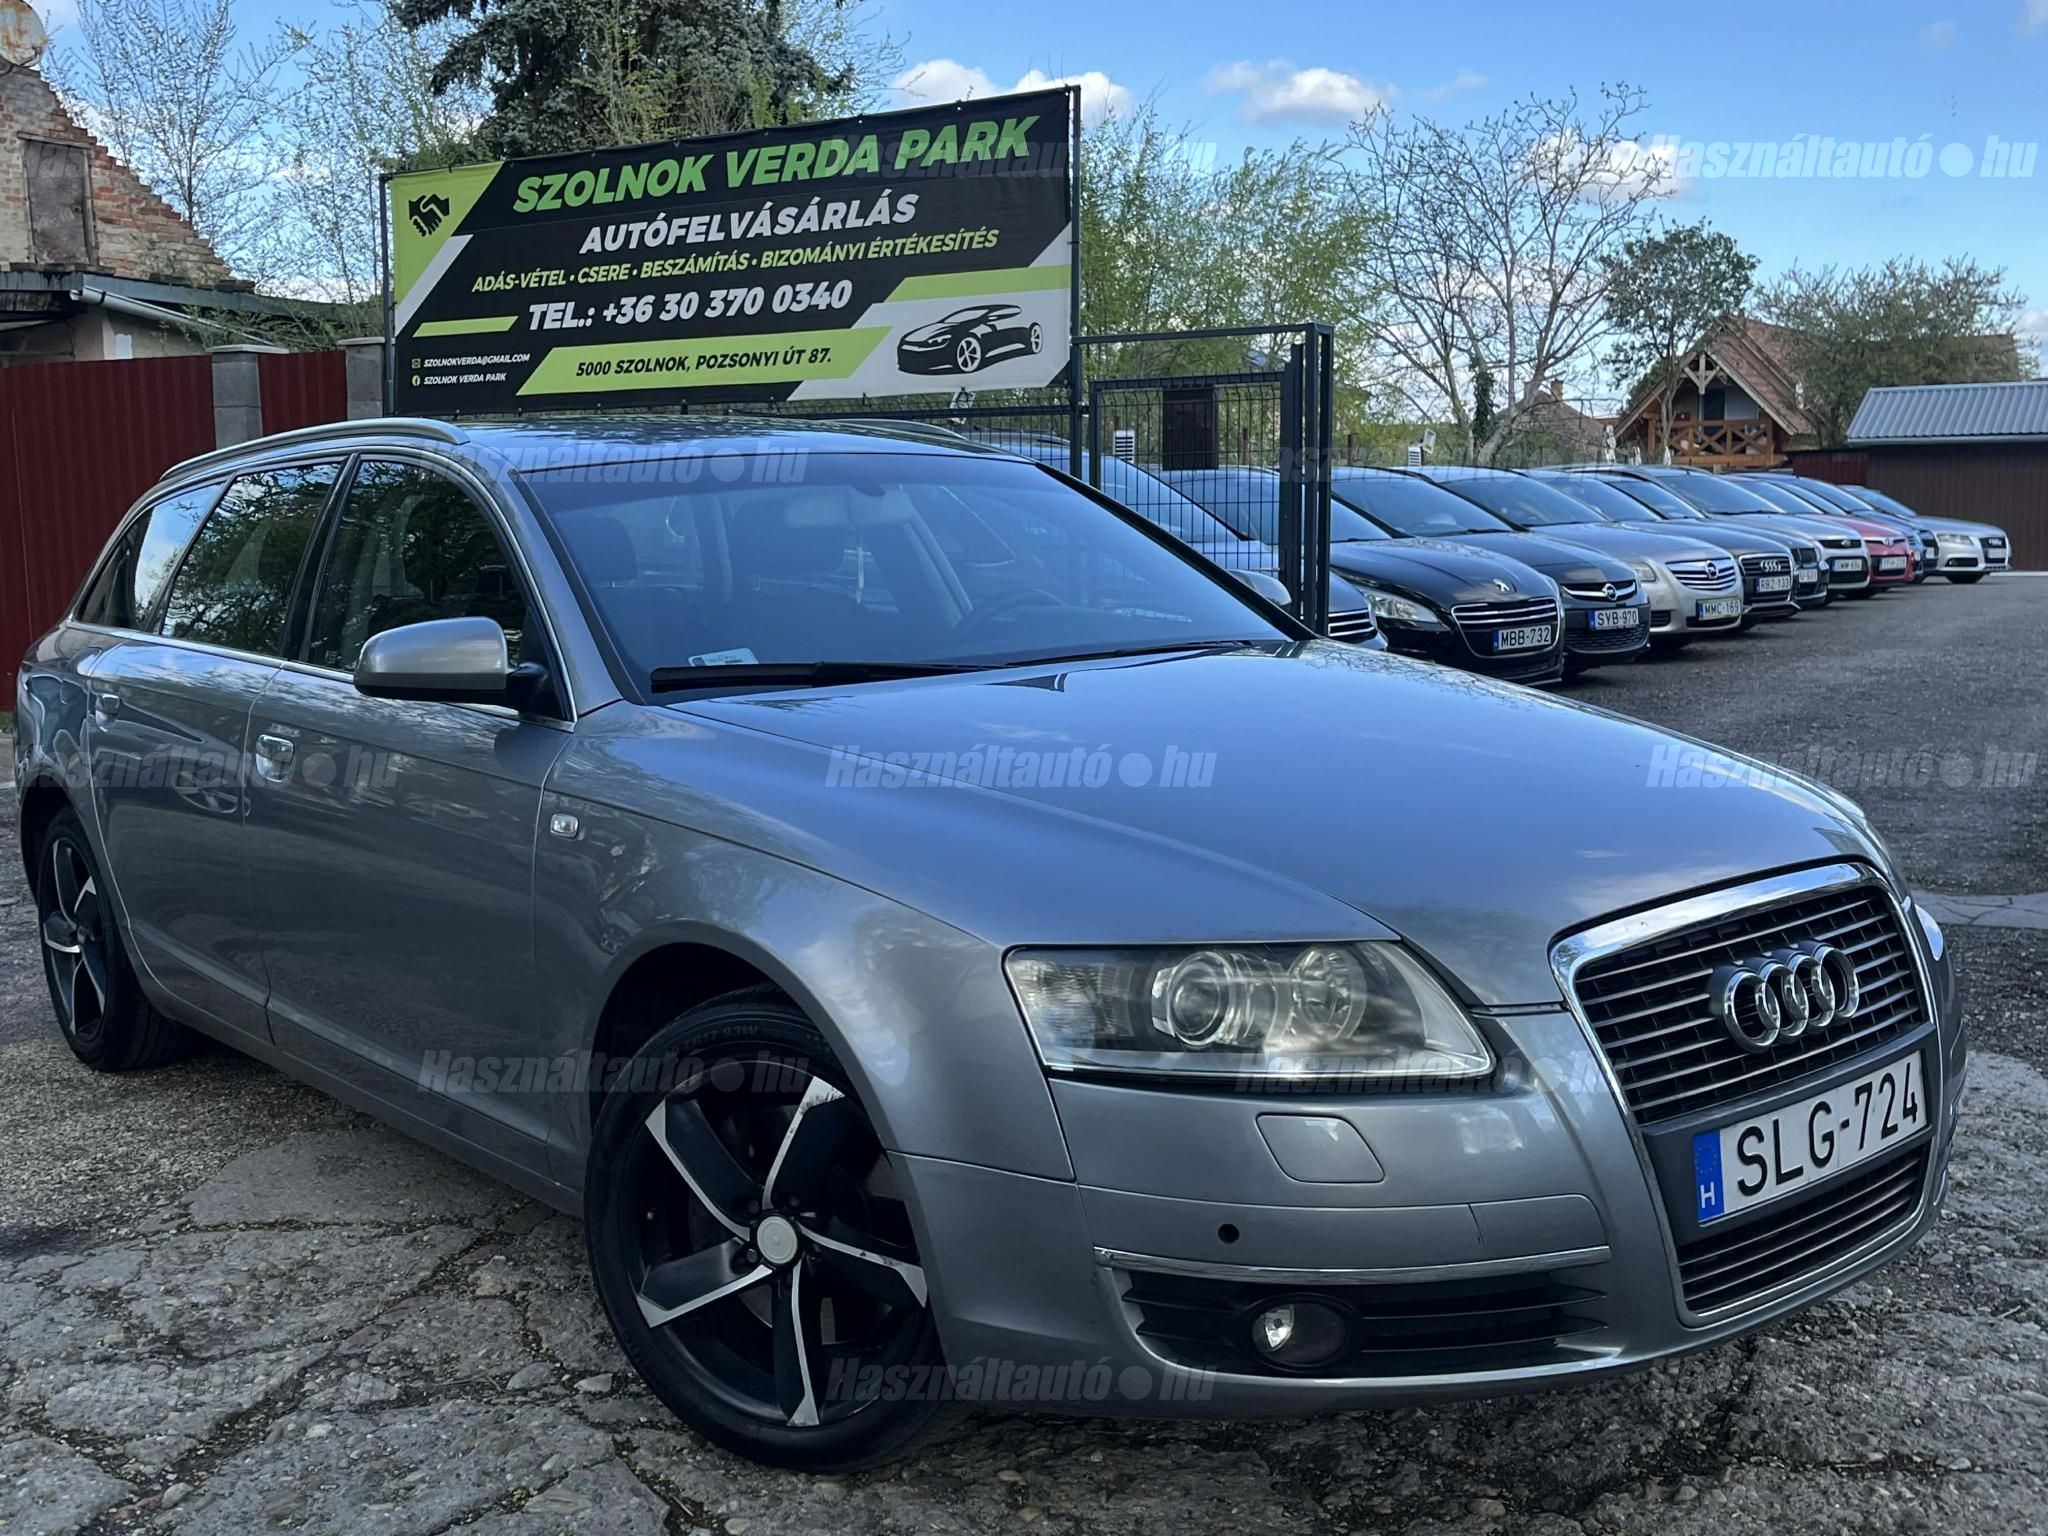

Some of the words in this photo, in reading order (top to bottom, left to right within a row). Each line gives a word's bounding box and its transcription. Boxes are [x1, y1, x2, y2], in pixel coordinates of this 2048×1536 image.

[513, 153, 715, 212] SZOLNOK
[726, 135, 879, 188] VERDA
[894, 115, 1040, 170] PARK
[579, 188, 920, 254] AUTÓFELVÁSÁRLÁS
[472, 265, 566, 293] ADÁS-VÉTEL
[577, 262, 629, 285] CSERE
[640, 249, 749, 279] BESZÁMÍTÁS
[760, 239, 864, 269] BIZOMÁNYI
[867, 226, 1000, 259] ÉRTÉKESÍTÉS
[529, 300, 595, 331] TEL.:
[602, 294, 655, 325] +36
[659, 290, 699, 321] 30
[704, 285, 764, 317] 370
[772, 279, 853, 315] 0340
[424, 353, 530, 368] SZOLNOKVERDA@GMAIL.COM
[576, 360, 611, 376] 5000
[614, 355, 690, 374] SZOLNOK,
[695, 350, 777, 371] POZSONYI
[783, 345, 805, 365] ÚT
[808, 347, 831, 365] 87.
[424, 375, 458, 385] SZOLNOK
[459, 373, 484, 383] VERDA
[486, 372, 507, 382] PARK
[1597, 608, 1638, 627] SYB-970
[1705, 599, 1739, 615] MMC-169
[1501, 626, 1550, 648] MBB-732
[1736, 1062, 1918, 1197] SLG-724
[1699, 1181, 1716, 1209] H
